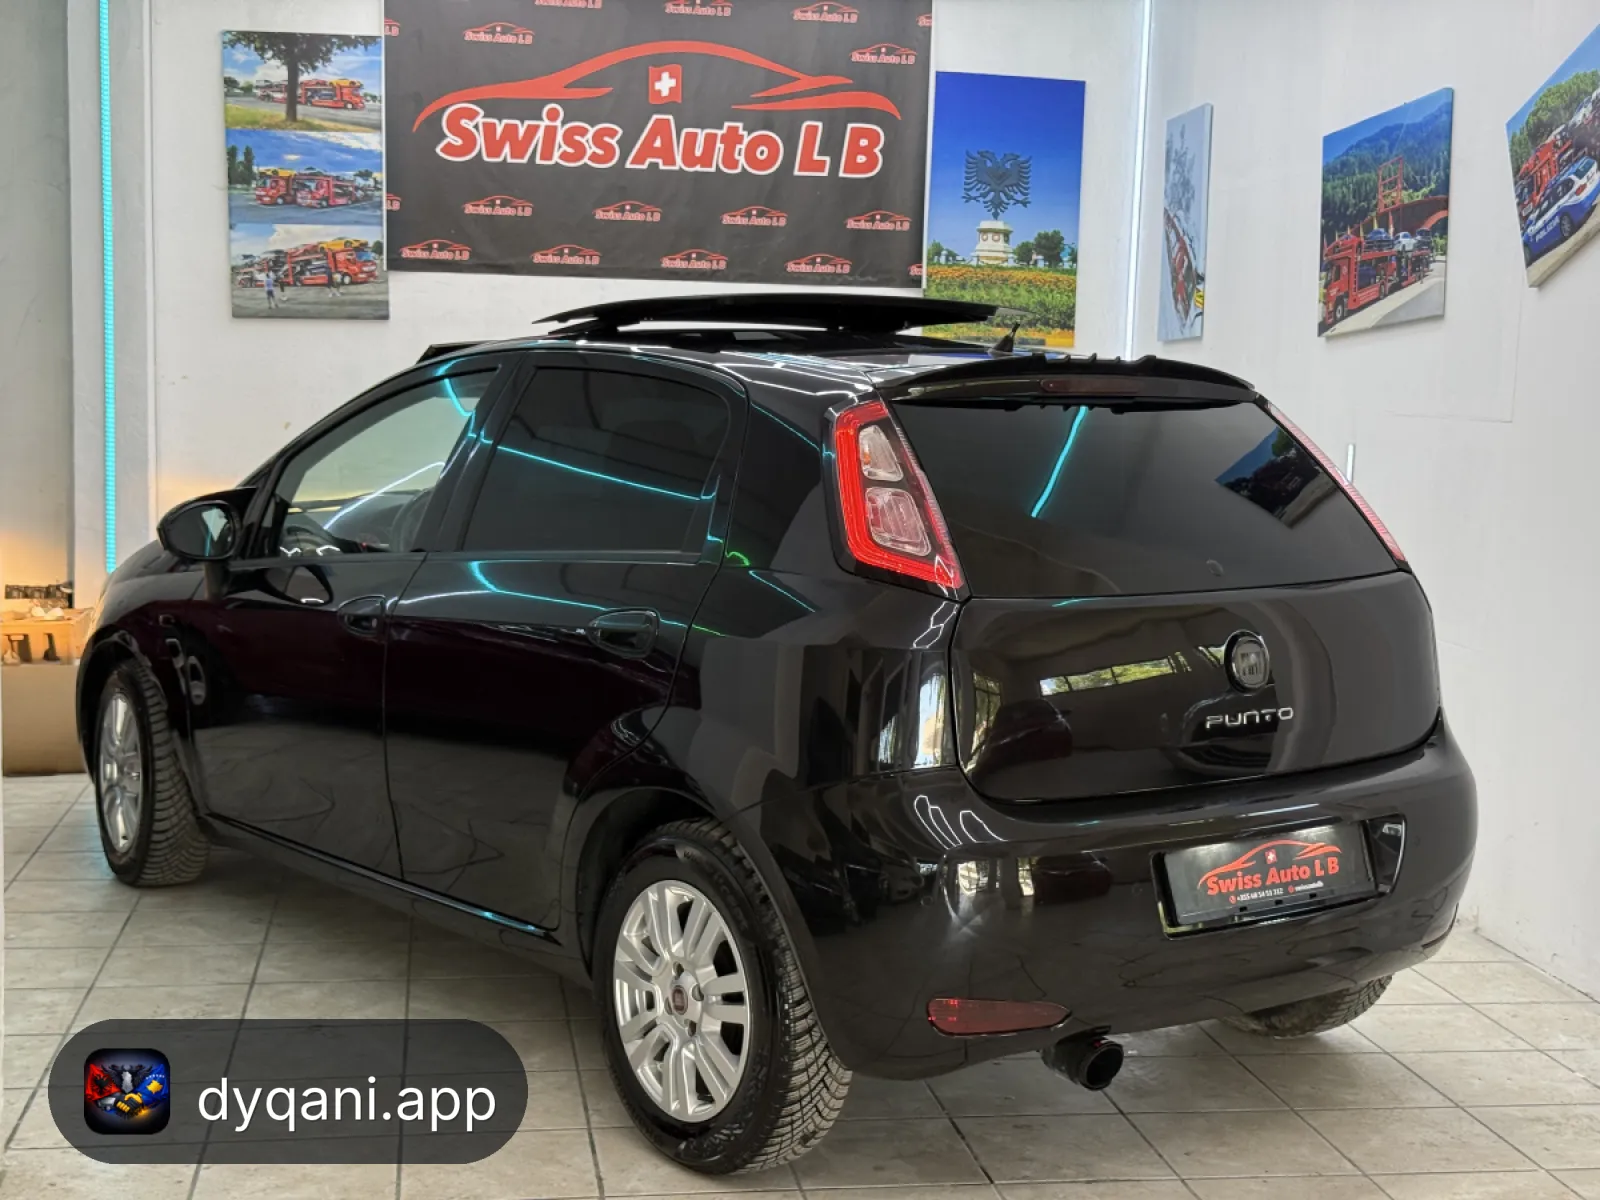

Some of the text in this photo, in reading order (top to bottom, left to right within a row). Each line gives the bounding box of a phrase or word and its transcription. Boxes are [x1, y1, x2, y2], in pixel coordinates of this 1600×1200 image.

[436, 103, 885, 178] Swiss Auto L B
[1205, 707, 1294, 729] PUNTO
[1206, 857, 1340, 895] Swiss Auto L B
